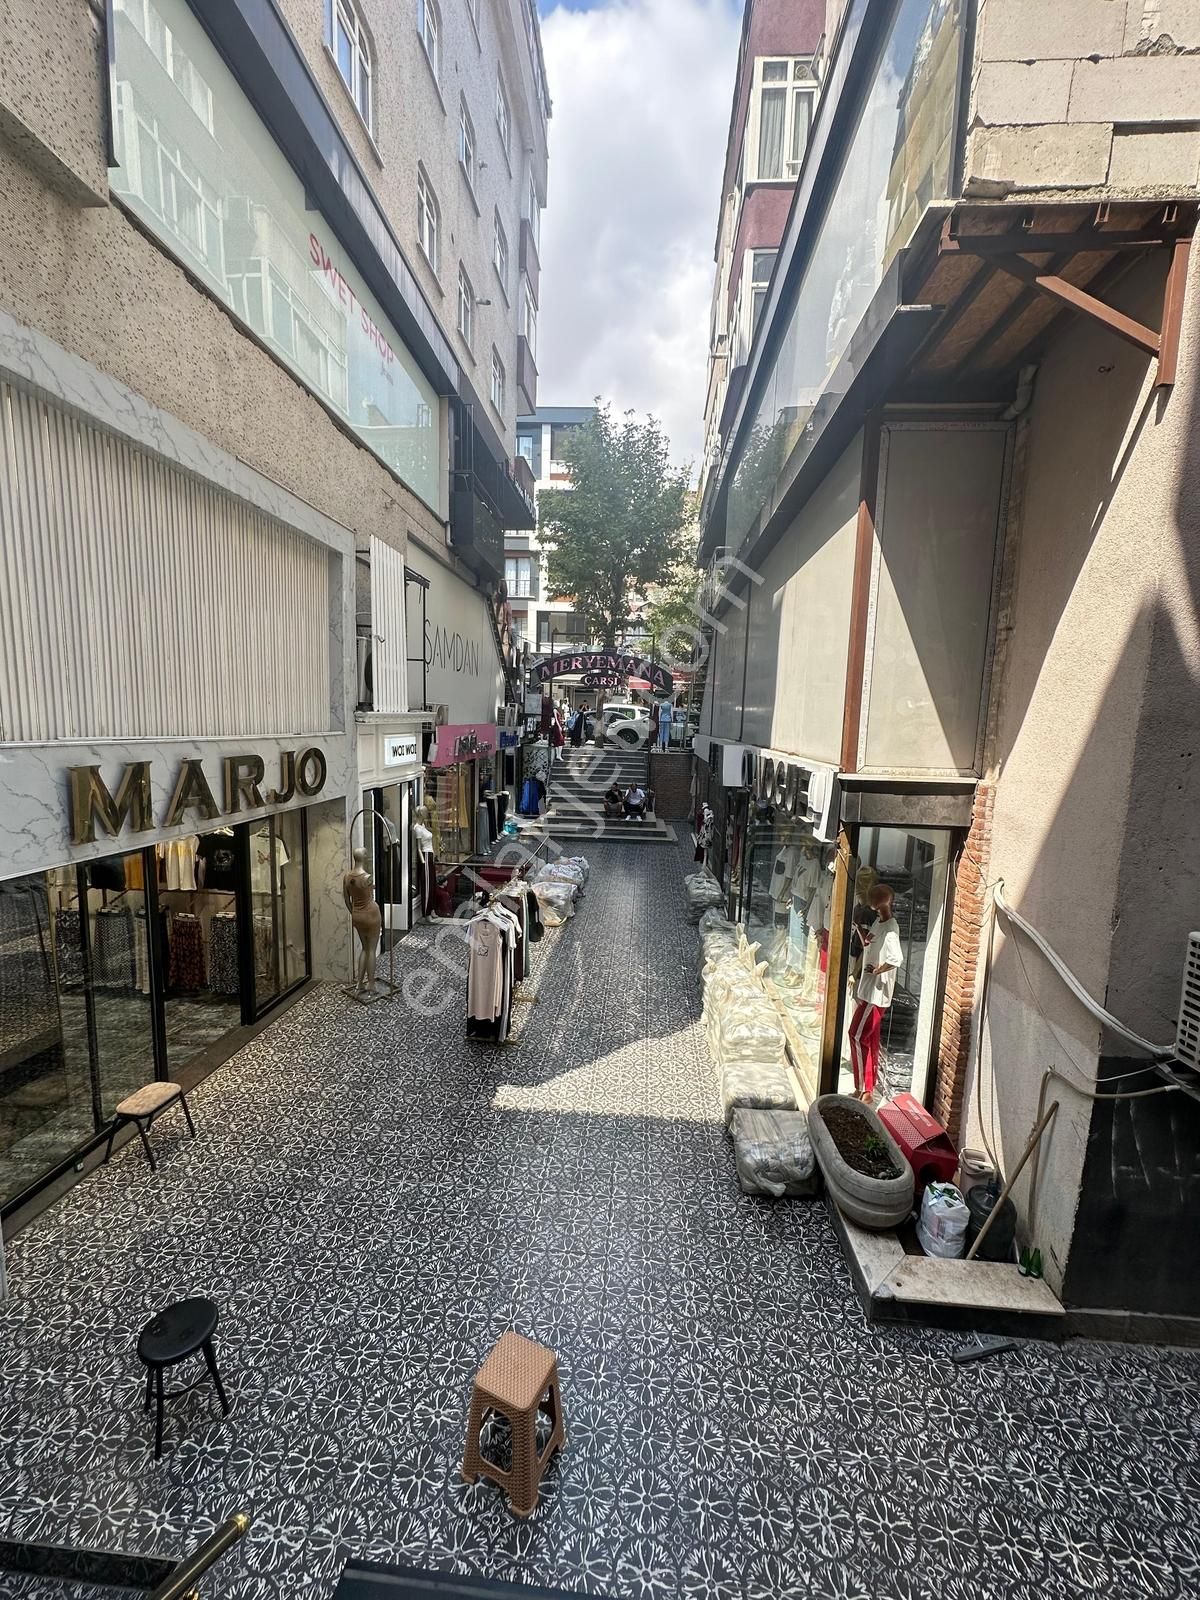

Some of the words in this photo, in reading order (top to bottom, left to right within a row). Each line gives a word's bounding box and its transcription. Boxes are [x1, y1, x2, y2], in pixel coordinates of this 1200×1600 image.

[361, 307, 394, 364] SHOP
[540, 654, 666, 687] MERYEMANA
[67, 747, 328, 846] MARJO
